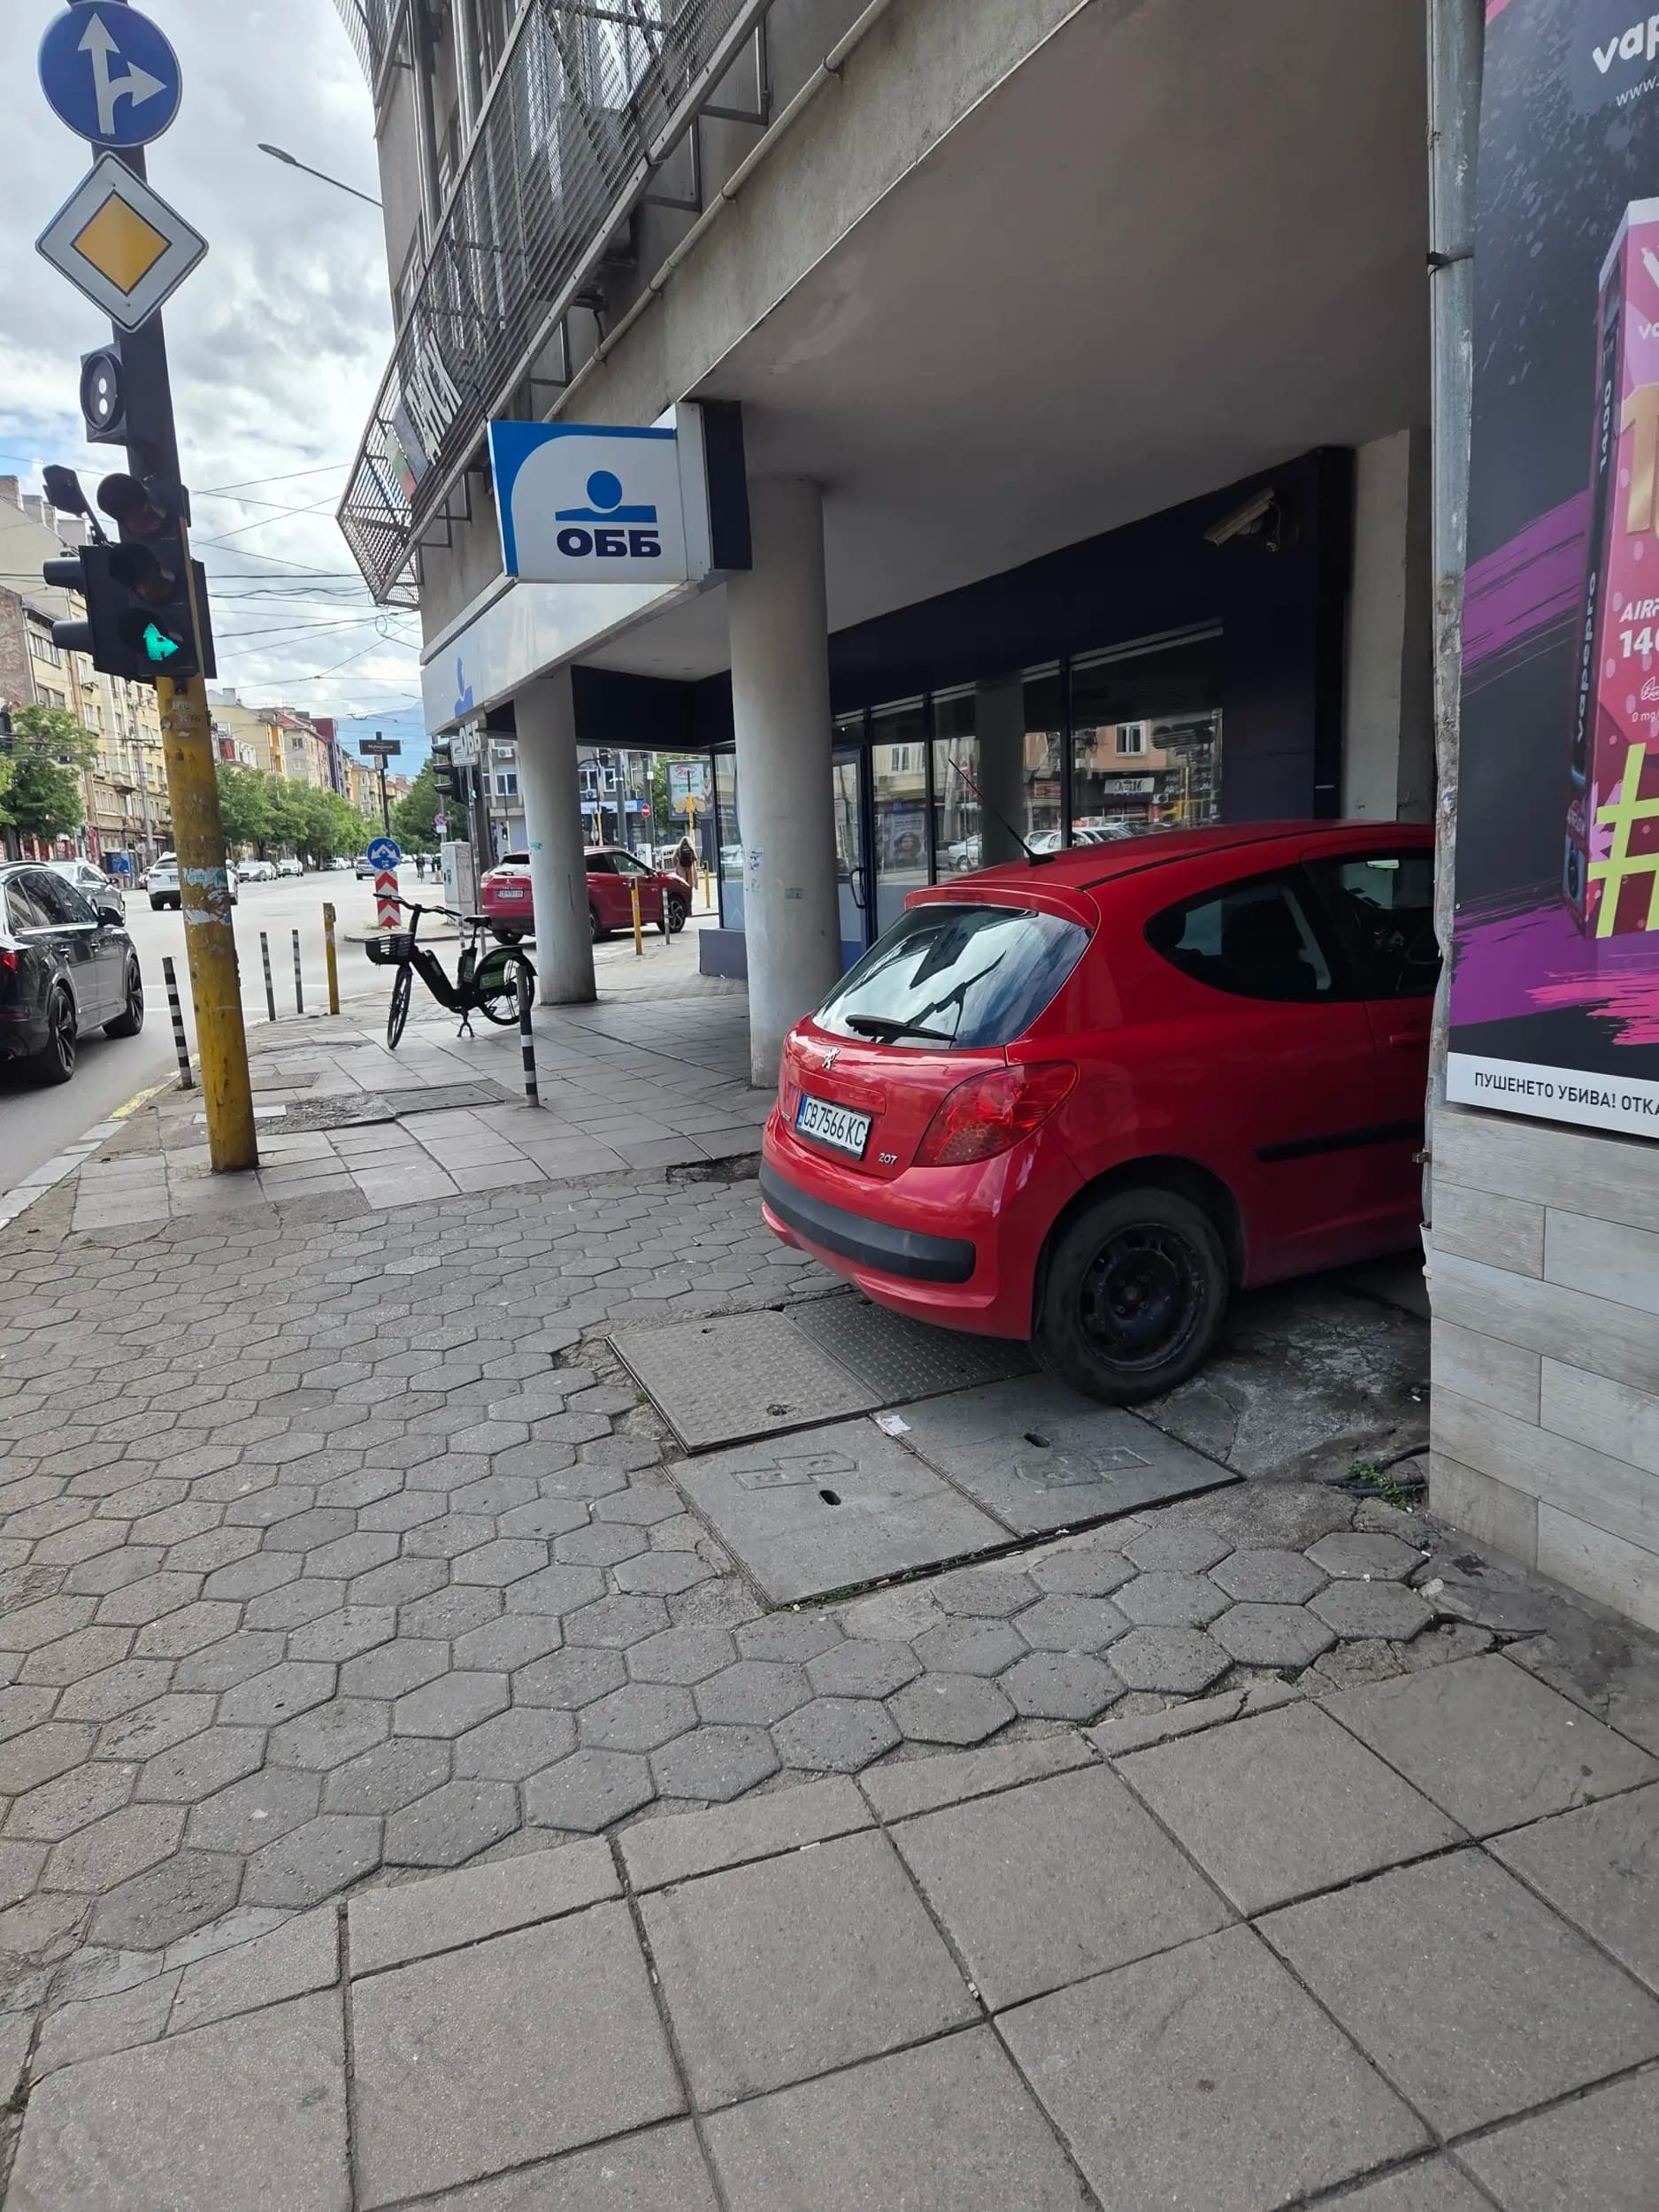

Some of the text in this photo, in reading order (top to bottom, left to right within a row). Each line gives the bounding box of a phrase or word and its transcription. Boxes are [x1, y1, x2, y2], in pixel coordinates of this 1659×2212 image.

[557, 528, 661, 557] ОББ
[1577, 571, 1596, 744] vapepro
[1474, 1071, 1555, 1098] ПУШЕНЕТО
[1557, 1085, 1617, 1109] УБИВА!
[879, 1153, 898, 1166] 207
